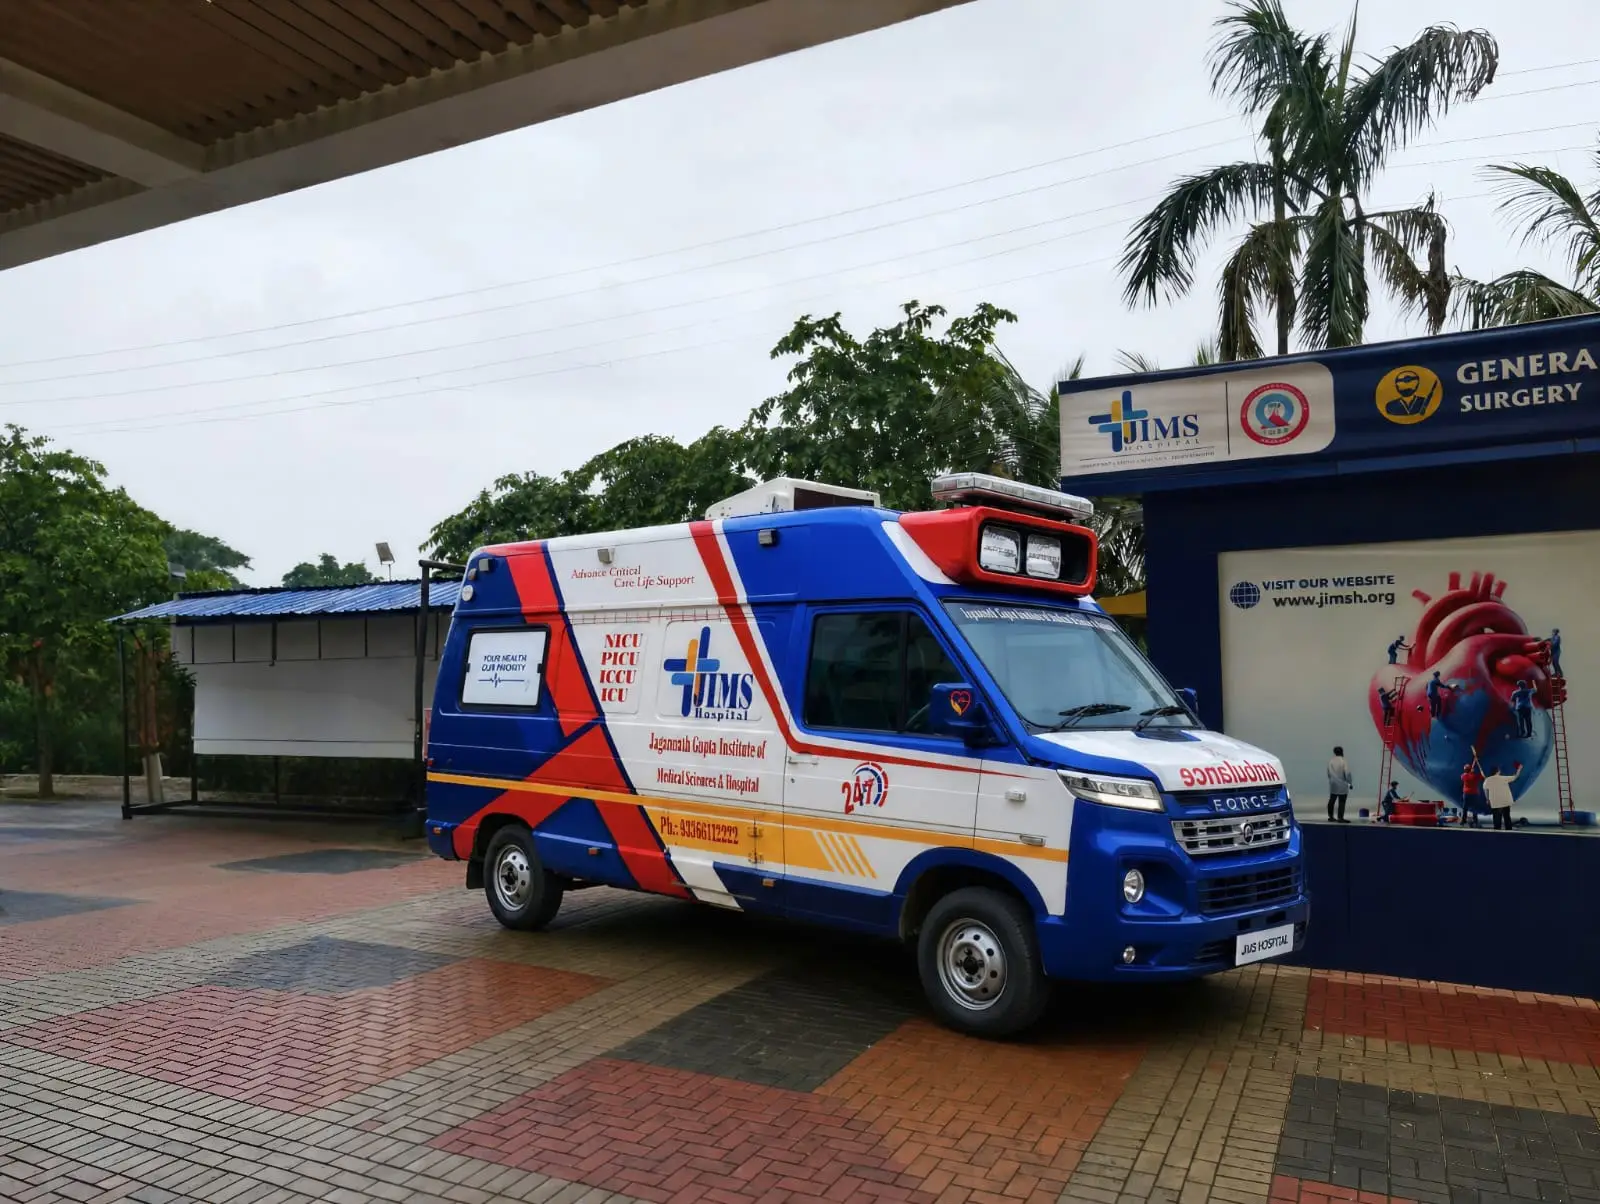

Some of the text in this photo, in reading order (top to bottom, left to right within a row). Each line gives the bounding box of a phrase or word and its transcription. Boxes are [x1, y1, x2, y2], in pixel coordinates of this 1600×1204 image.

[1456, 348, 1598, 384] GENERA
[1460, 382, 1582, 412] SURGERY
[1123, 414, 1200, 445] JIMS
[571, 565, 641, 579] Advance Critical
[614, 575, 695, 589] Care Life Support
[1262, 575, 1395, 591] VISIT OUR WEBSITE
[1272, 591, 1396, 608] www.jimsh.org
[604, 633, 643, 648] NICU
[502, 654, 527, 662] HEALTH
[601, 651, 641, 666] PICU
[600, 669, 637, 684] ICCU
[601, 688, 628, 702] ICU
[693, 673, 754, 710] JIMS
[695, 707, 748, 722] Hospital
[649, 732, 767, 759] Jagannath Gupta Institute of
[657, 767, 685, 785] Medical
[685, 771, 717, 789] Sciences
[725, 774, 760, 795] Hospital
[1213, 795, 1269, 812] FORCE
